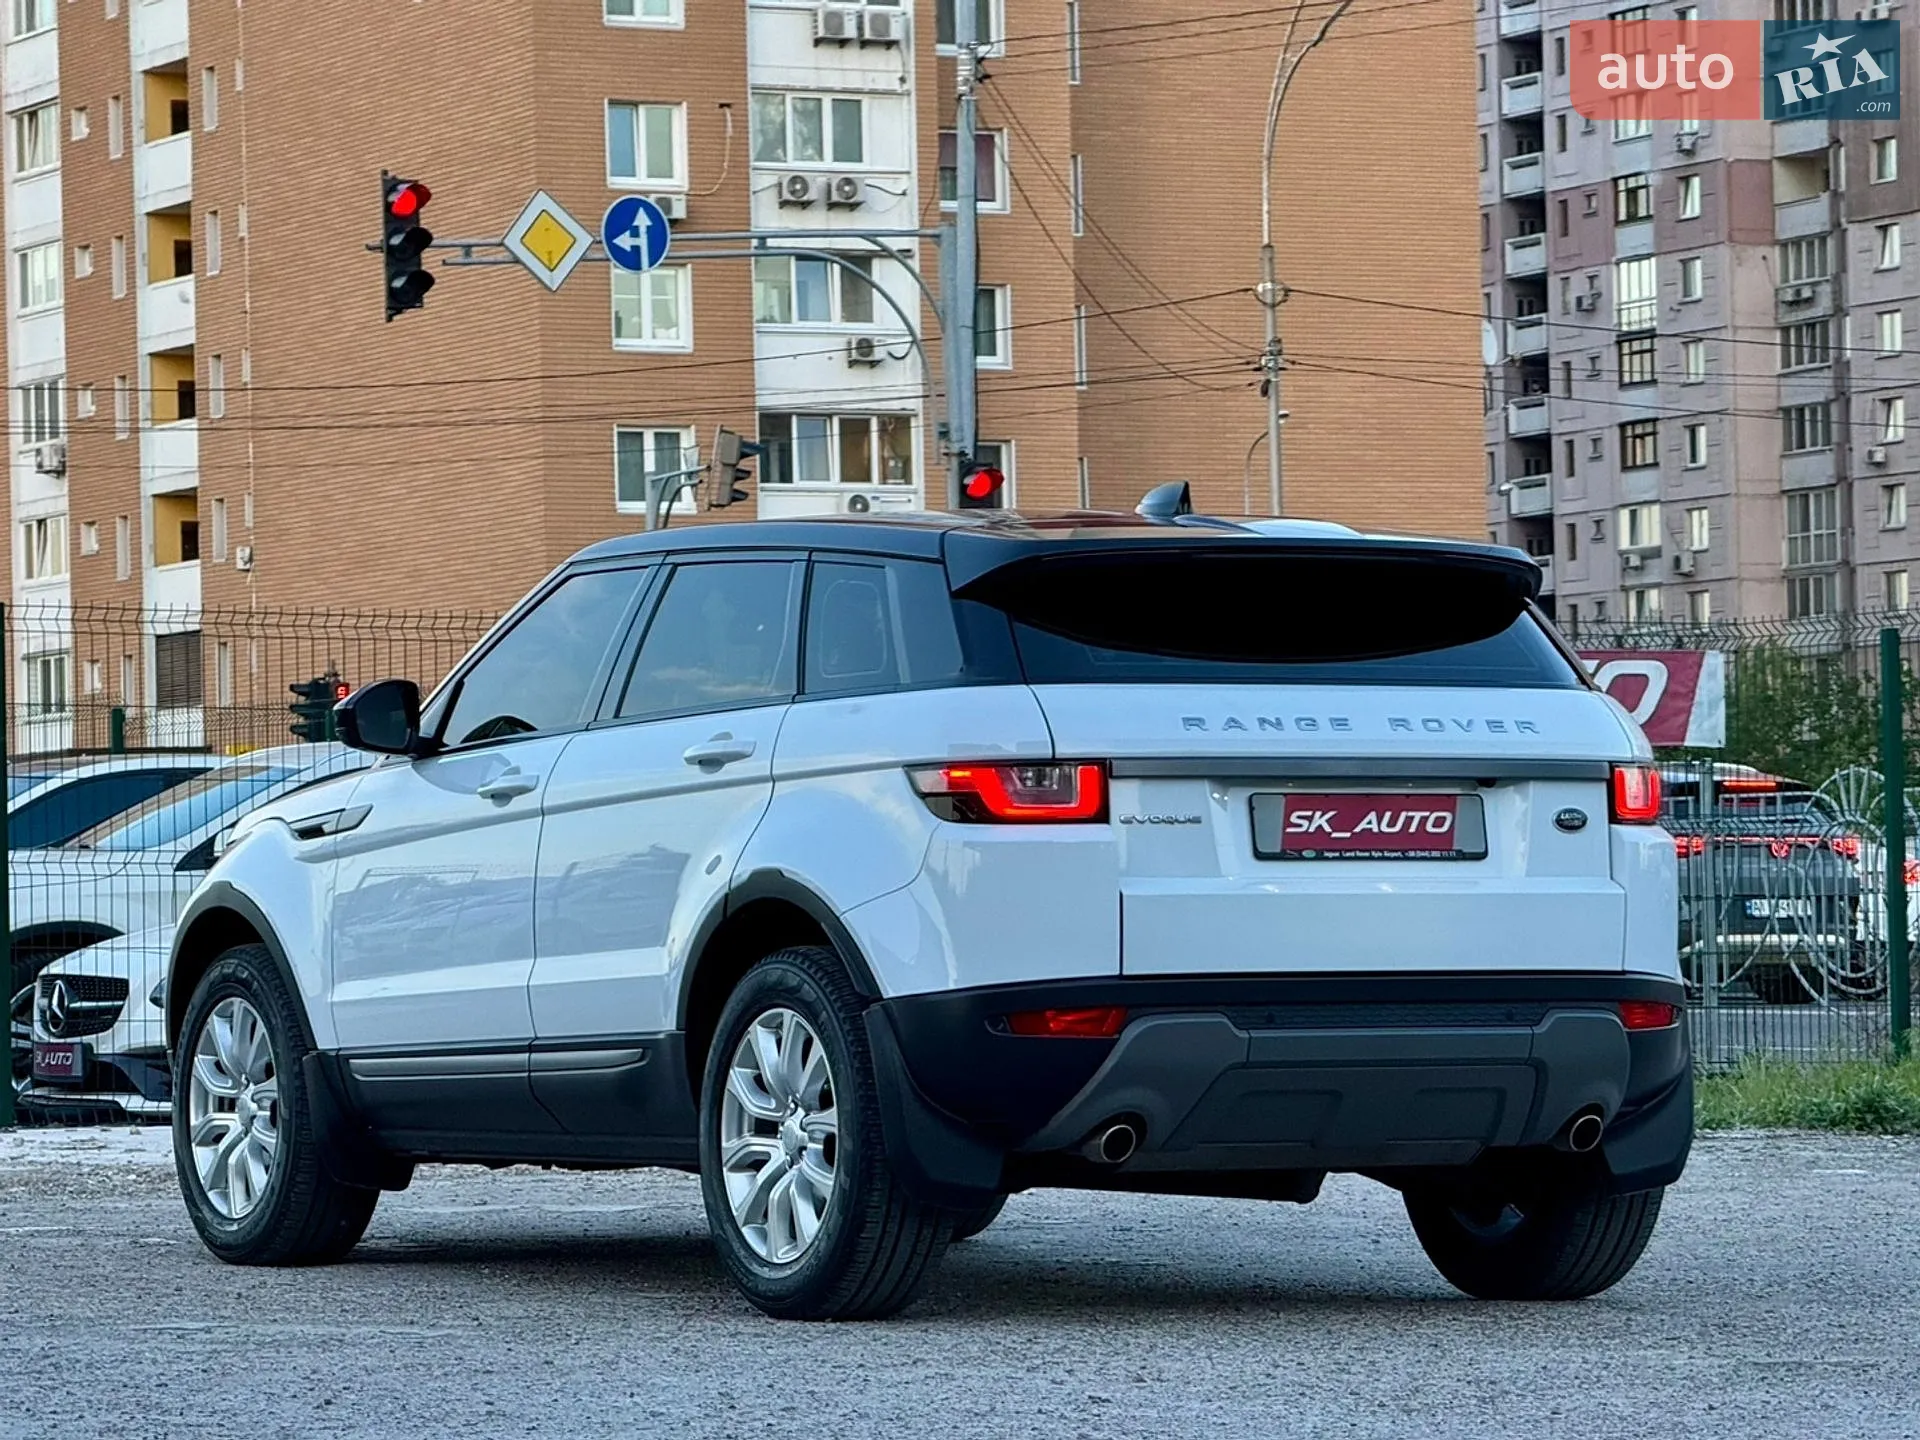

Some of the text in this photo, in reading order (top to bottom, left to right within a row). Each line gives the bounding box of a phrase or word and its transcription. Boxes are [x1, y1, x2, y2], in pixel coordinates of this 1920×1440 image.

[1582, 659, 1669, 727] O
[1181, 716, 1540, 735] RANGE ROVER
[1119, 814, 1202, 825] EVOQUE
[1285, 811, 1453, 838] SK_AUTO
